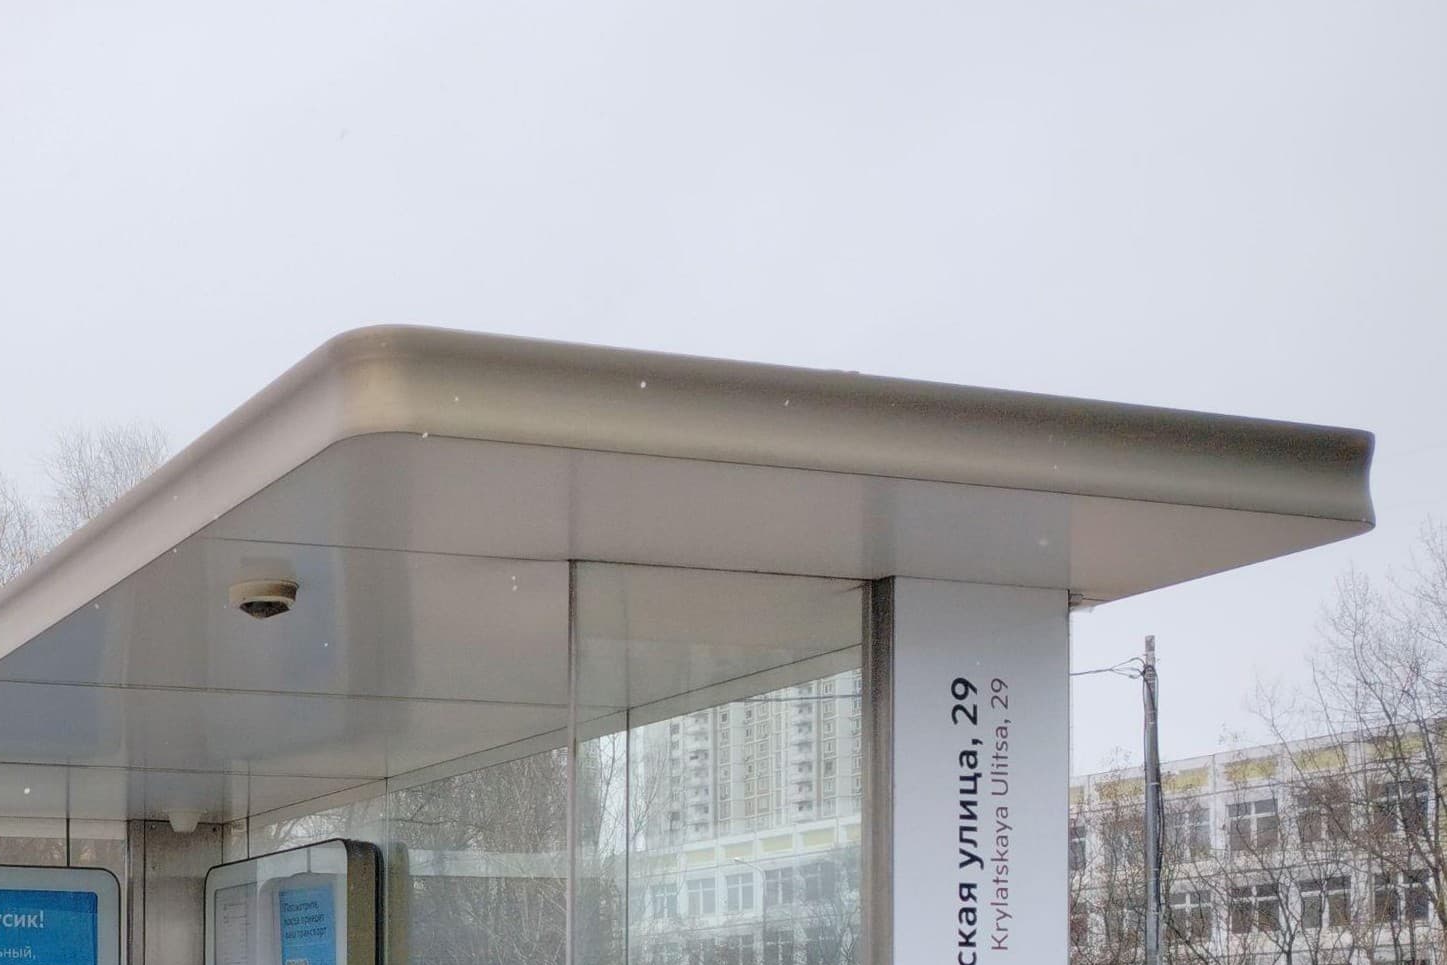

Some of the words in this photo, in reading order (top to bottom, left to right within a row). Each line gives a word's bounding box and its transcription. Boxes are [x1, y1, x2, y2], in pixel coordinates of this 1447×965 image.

[951, 677, 979, 725] 29
[990, 677, 1009, 710] 29
[990, 718, 1012, 797] Ulitsa,
[956, 738, 984, 870] улица,
[990, 806, 1013, 952] Krylatskaya
